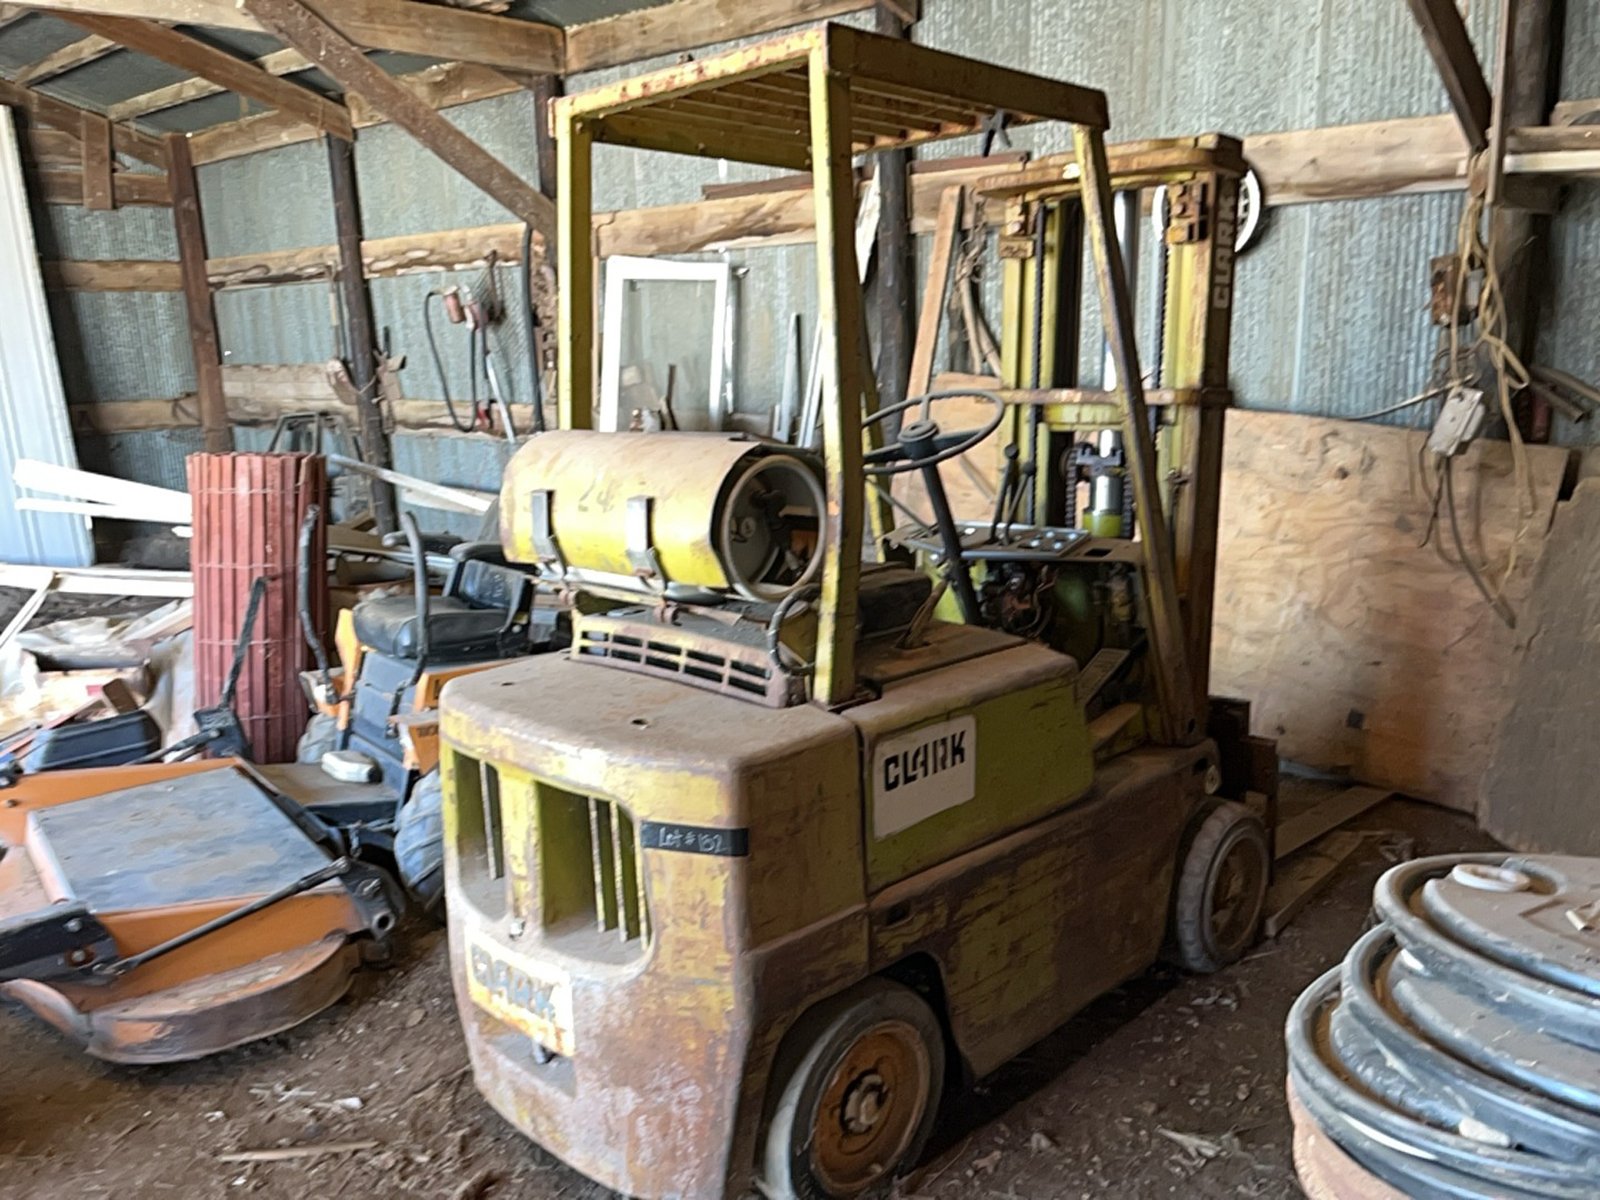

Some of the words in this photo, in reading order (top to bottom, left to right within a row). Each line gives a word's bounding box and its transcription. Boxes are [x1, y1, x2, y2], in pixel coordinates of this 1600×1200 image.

[1213, 196, 1236, 309] CLARK
[884, 730, 967, 791] CLARK
[659, 826, 683, 848] Lot
